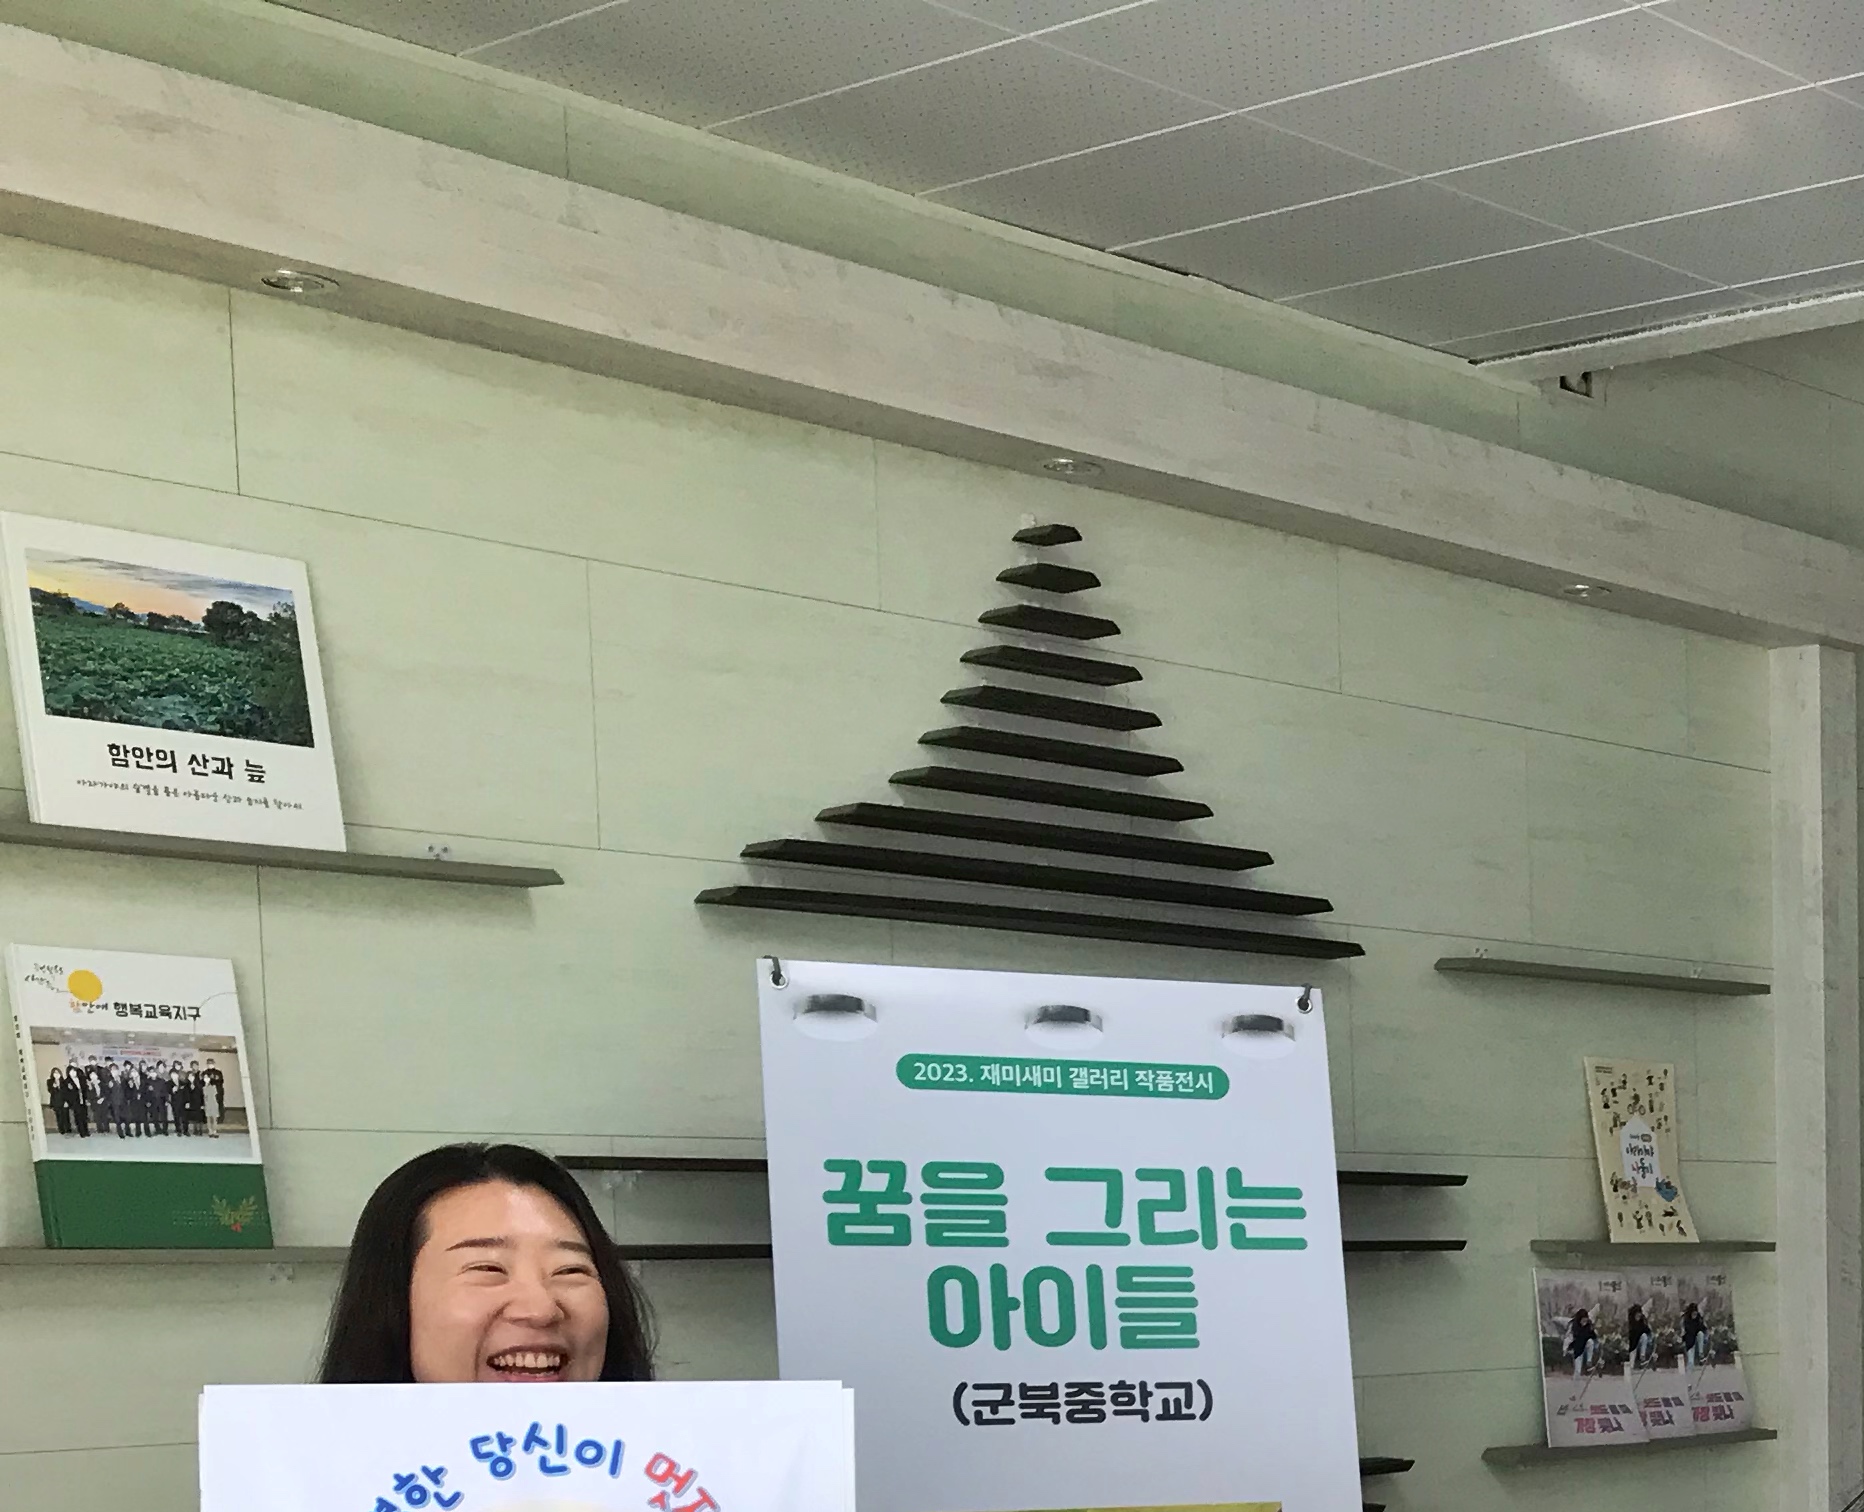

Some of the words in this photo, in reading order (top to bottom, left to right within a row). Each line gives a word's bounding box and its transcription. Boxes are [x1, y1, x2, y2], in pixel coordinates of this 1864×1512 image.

[107, 743, 178, 773] 함안의
[188, 753, 234, 779] 산과
[244, 759, 266, 783] 늪
[113, 1001, 201, 1020] 행복교육지구
[914, 1062, 974, 1083] 2023.
[980, 1063, 1062, 1088] 재미새미
[1069, 1067, 1129, 1091] 갤러리
[1134, 1069, 1214, 1094] 작품전시
[822, 1158, 1010, 1247] 꿈을
[1044, 1166, 1308, 1251] 그리는
[927, 1262, 1201, 1351] 아이들
[952, 1379, 1214, 1426] (군북중학교)
[470, 1421, 626, 1480] 당신이
